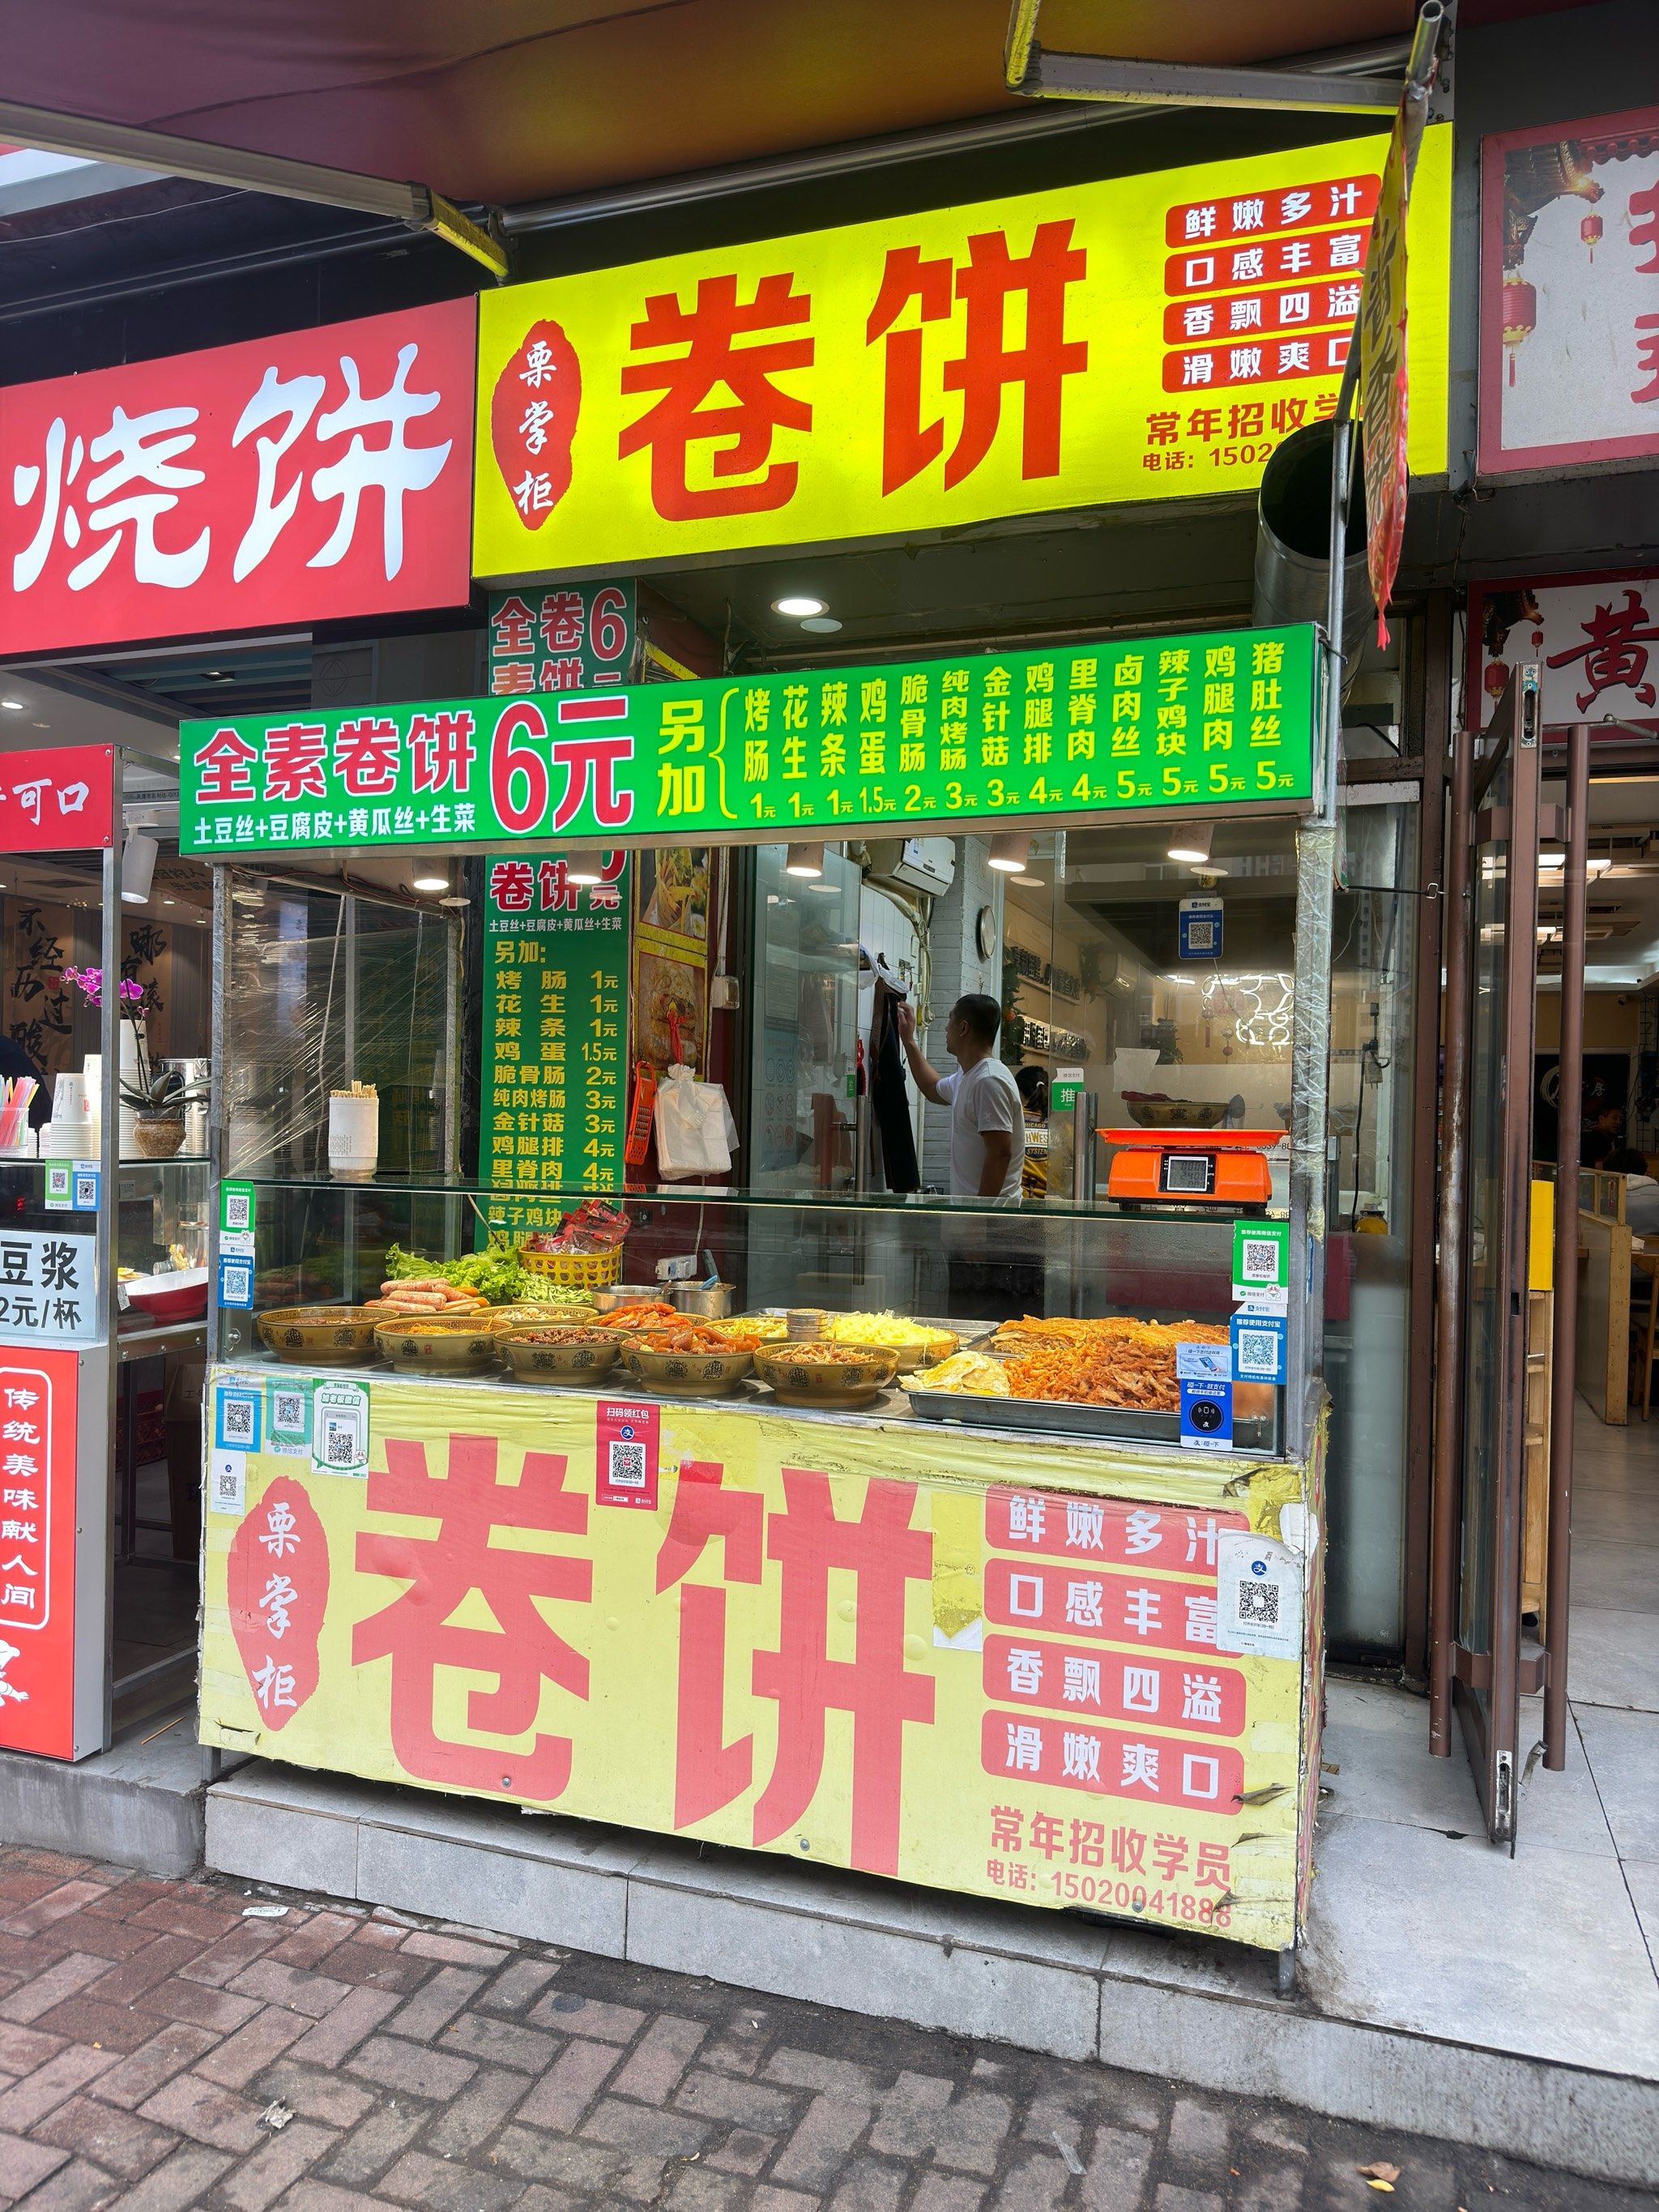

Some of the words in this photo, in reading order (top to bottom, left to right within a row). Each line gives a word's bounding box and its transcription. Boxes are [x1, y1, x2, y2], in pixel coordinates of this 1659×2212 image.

[1185, 183, 1363, 240] 鲜嫩多汁
[1185, 234, 1362, 288] 口感丰富
[1183, 284, 1361, 337] 香飘四溢
[618, 218, 1089, 522] 卷饼
[1182, 335, 1354, 386] 滑嫩爽口
[1145, 393, 1342, 446] 常年招收
[14, 343, 453, 592] 烧饼
[1546, 589, 1659, 714] 黄
[940, 669, 970, 771] 纯肉烤肠
[982, 666, 1012, 767] 金针菇
[1024, 662, 1054, 764] 鸡腿排
[1068, 658, 1098, 761] 里脊肉
[1111, 655, 1145, 758] 卤肉丝
[1156, 649, 1190, 758] 辣子鸡块
[1203, 645, 1235, 751] 鸡腿肉
[1249, 642, 1284, 747] 猪肚丝
[744, 688, 770, 783] 烤肠
[781, 685, 808, 780] 花生
[820, 681, 848, 778] 辣条
[859, 678, 887, 775] 鸡蛋
[899, 676, 928, 773] 脆骨肠
[194, 710, 476, 804] 全素卷饼
[488, 694, 635, 835] 6元
[657, 699, 705, 817] 另加
[1162, 767, 1199, 796] 5元
[1209, 763, 1246, 793] 5元
[1256, 760, 1294, 791] 5元
[0, 778, 89, 826] 可口
[749, 792, 776, 818] 1元
[788, 792, 815, 818] 1元
[826, 789, 854, 816] 1元
[904, 784, 936, 811] 2元
[945, 782, 978, 809] 3元
[987, 779, 1020, 807] 3元
[1029, 776, 1063, 805] 4元
[1072, 773, 1107, 801] 4元
[1117, 771, 1153, 799] 5元
[194, 803, 476, 845] 土豆丝+豆腐皮+黄瓜丝+生菜
[489, 916, 623, 933] 土豆丝+豆腐皮+黄瓜丝+生菜
[590, 994, 618, 1014] 1元
[591, 971, 618, 989] 1元
[582, 1042, 617, 1062] 1.5元
[590, 1018, 617, 1037] 1元
[493, 1065, 565, 1085] 脆骨肠
[586, 1066, 616, 1086] 2元
[493, 1089, 565, 1109] 纯肉烤肠
[585, 1091, 616, 1110] 3元
[1060, 1088, 1076, 1103] 推
[492, 1136, 564, 1157] 鸡腿排
[583, 1138, 615, 1158] 4元
[493, 1113, 565, 1133] 金针菇
[585, 1114, 616, 1134] 3元
[491, 1159, 562, 1181] 里脊肉
[582, 1162, 614, 1181] 4元
[0, 1240, 79, 1291] 豆浆
[0, 1296, 83, 1330] 2元/杯
[1236, 1318, 1282, 1328] 推荐使用支付宝
[321, 1393, 361, 1407] 加老板微信
[606, 1407, 650, 1420] 扫码领红包
[1, 1387, 41, 1610] 传统美味献人间
[1009, 1494, 1218, 1565] 鲜嫩多汁
[1009, 1574, 1218, 1644] 口感丰富
[352, 1433, 936, 1877] 卷饼
[1007, 1648, 1222, 1723] 香飘四溢
[1005, 1722, 1219, 1800] 滑嫩爽口
[990, 1804, 1231, 1891] 常年招收学员
